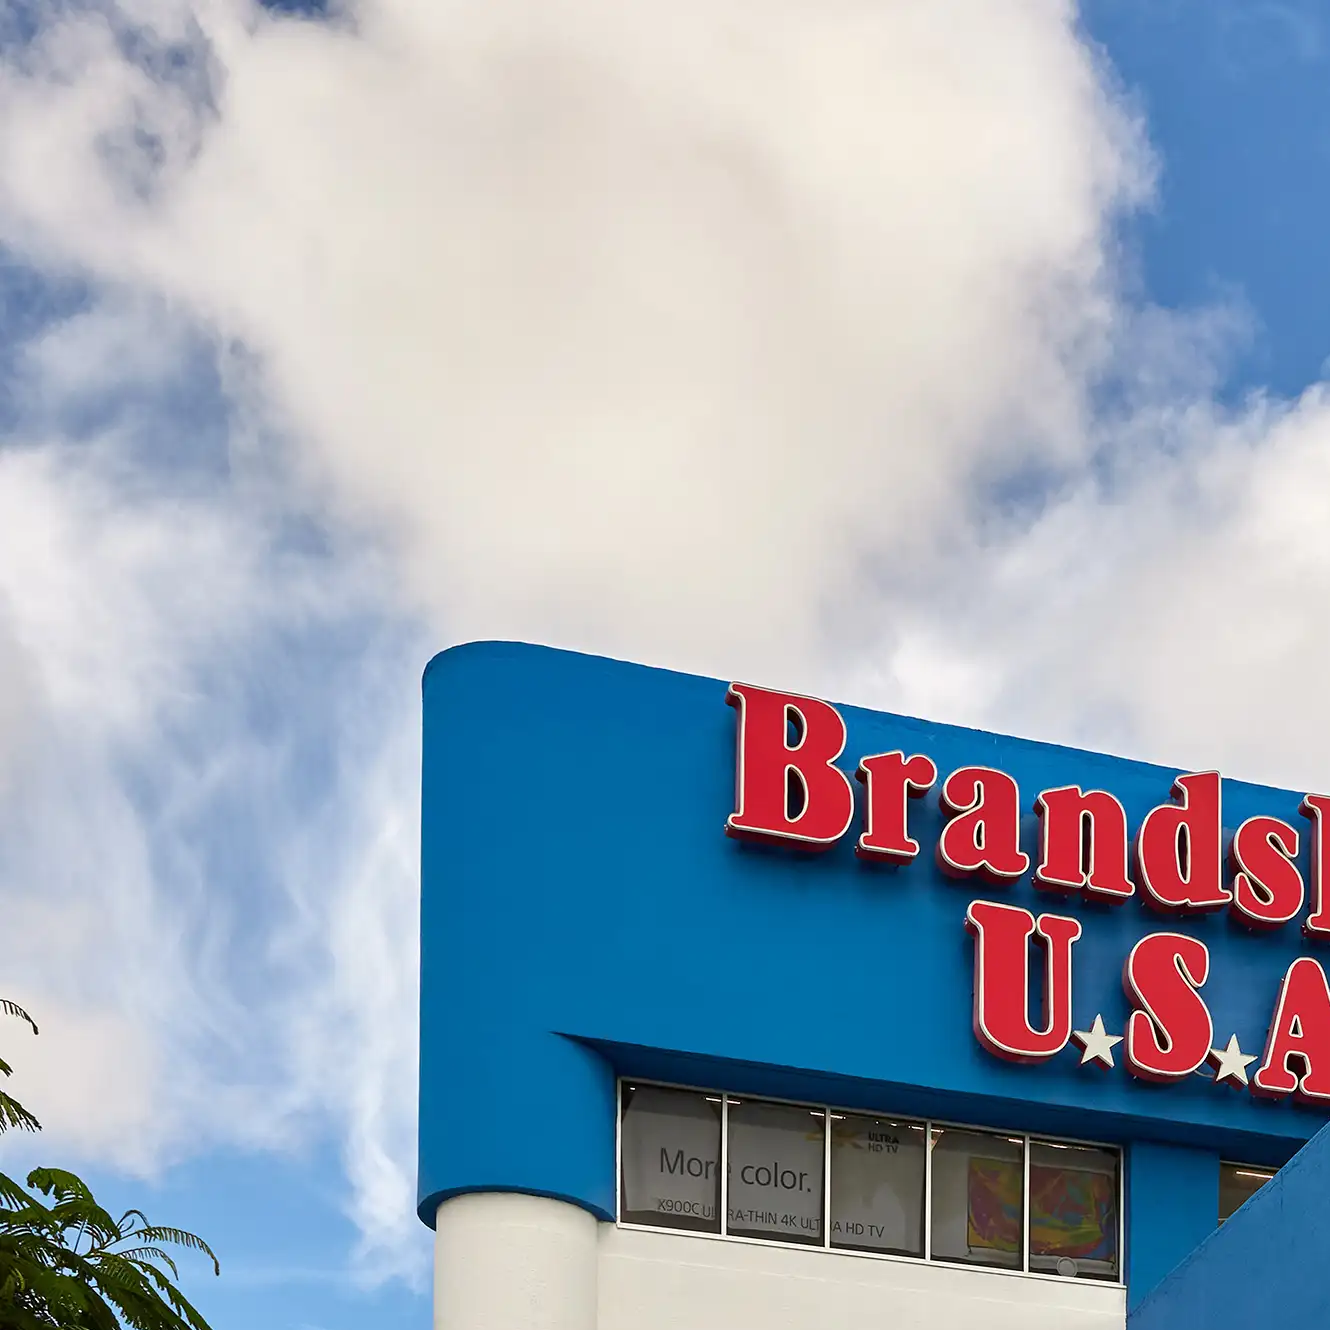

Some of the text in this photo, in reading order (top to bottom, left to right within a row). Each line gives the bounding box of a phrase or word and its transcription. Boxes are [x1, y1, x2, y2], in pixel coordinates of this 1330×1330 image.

[868, 1131, 899, 1144] ULTRA
[868, 1142, 899, 1153] HD TV
[741, 1162, 812, 1193] color.
[658, 1199, 885, 1238] X900C ULRA-THIN 4K ULTA HD TV
